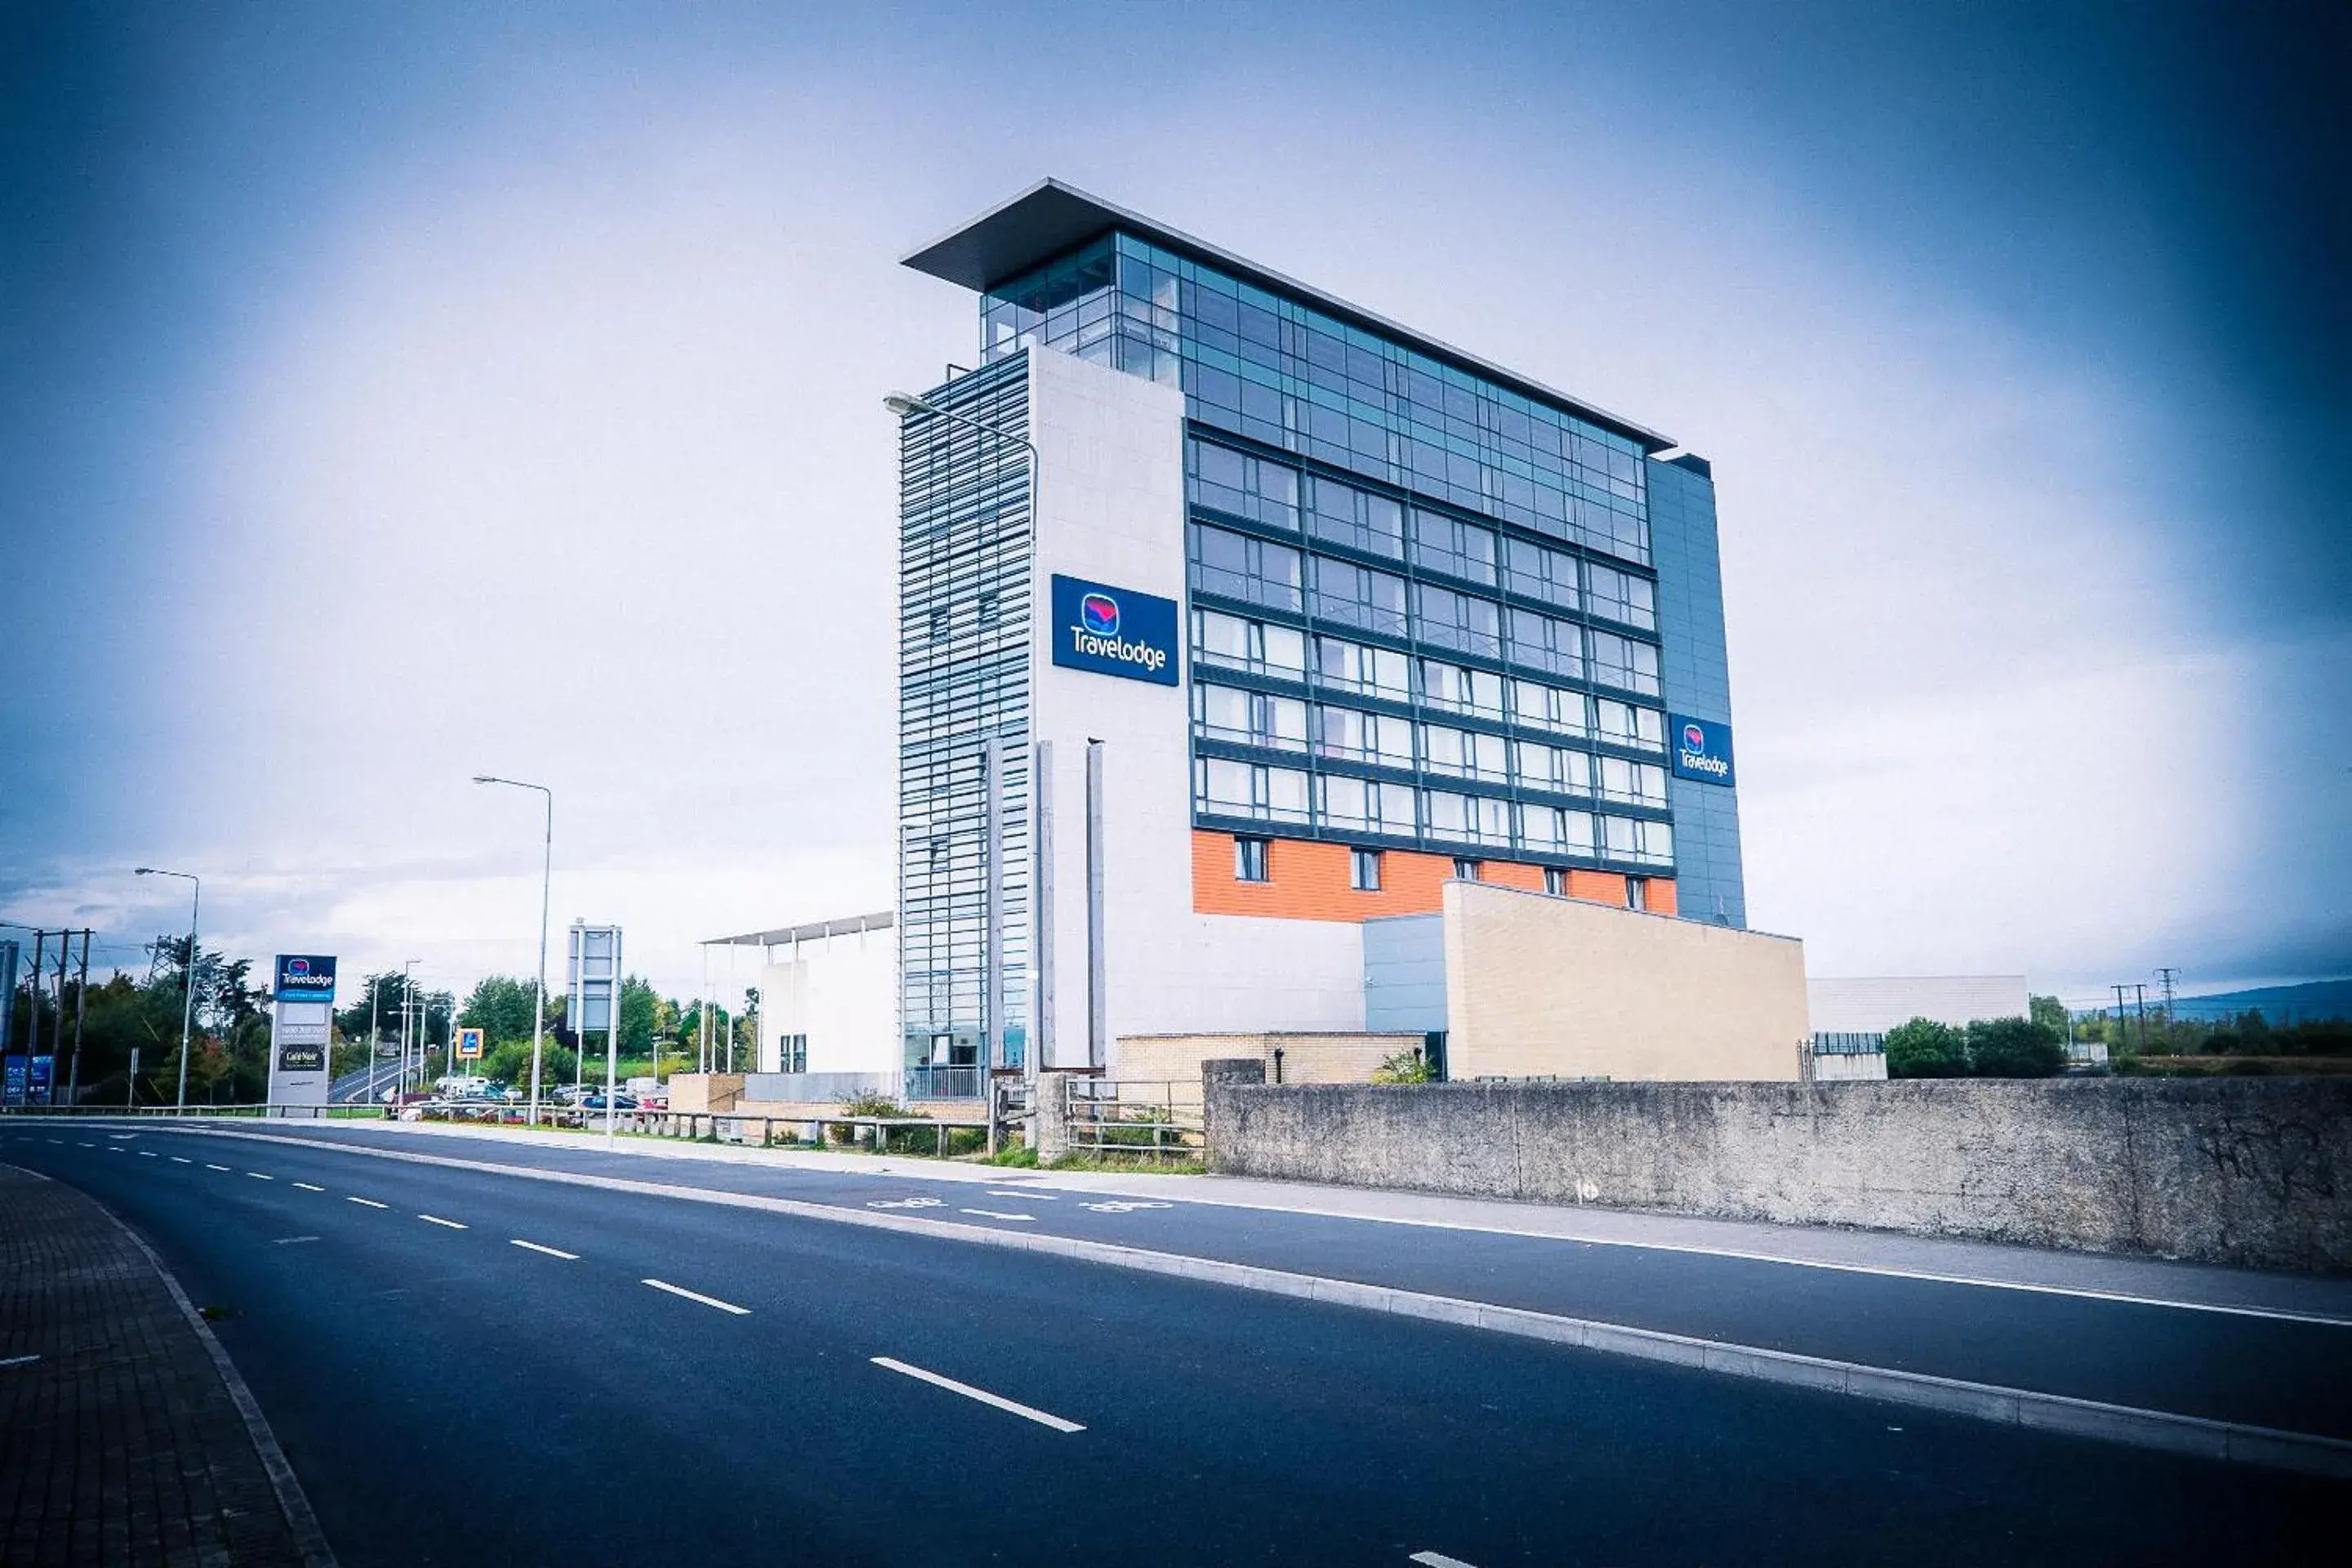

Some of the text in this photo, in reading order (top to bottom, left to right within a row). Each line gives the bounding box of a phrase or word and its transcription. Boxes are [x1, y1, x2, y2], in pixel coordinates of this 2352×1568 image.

[1071, 625, 1166, 671] Travelodge
[1678, 748, 1729, 777] Travelodge
[282, 973, 333, 987] Travelodge
